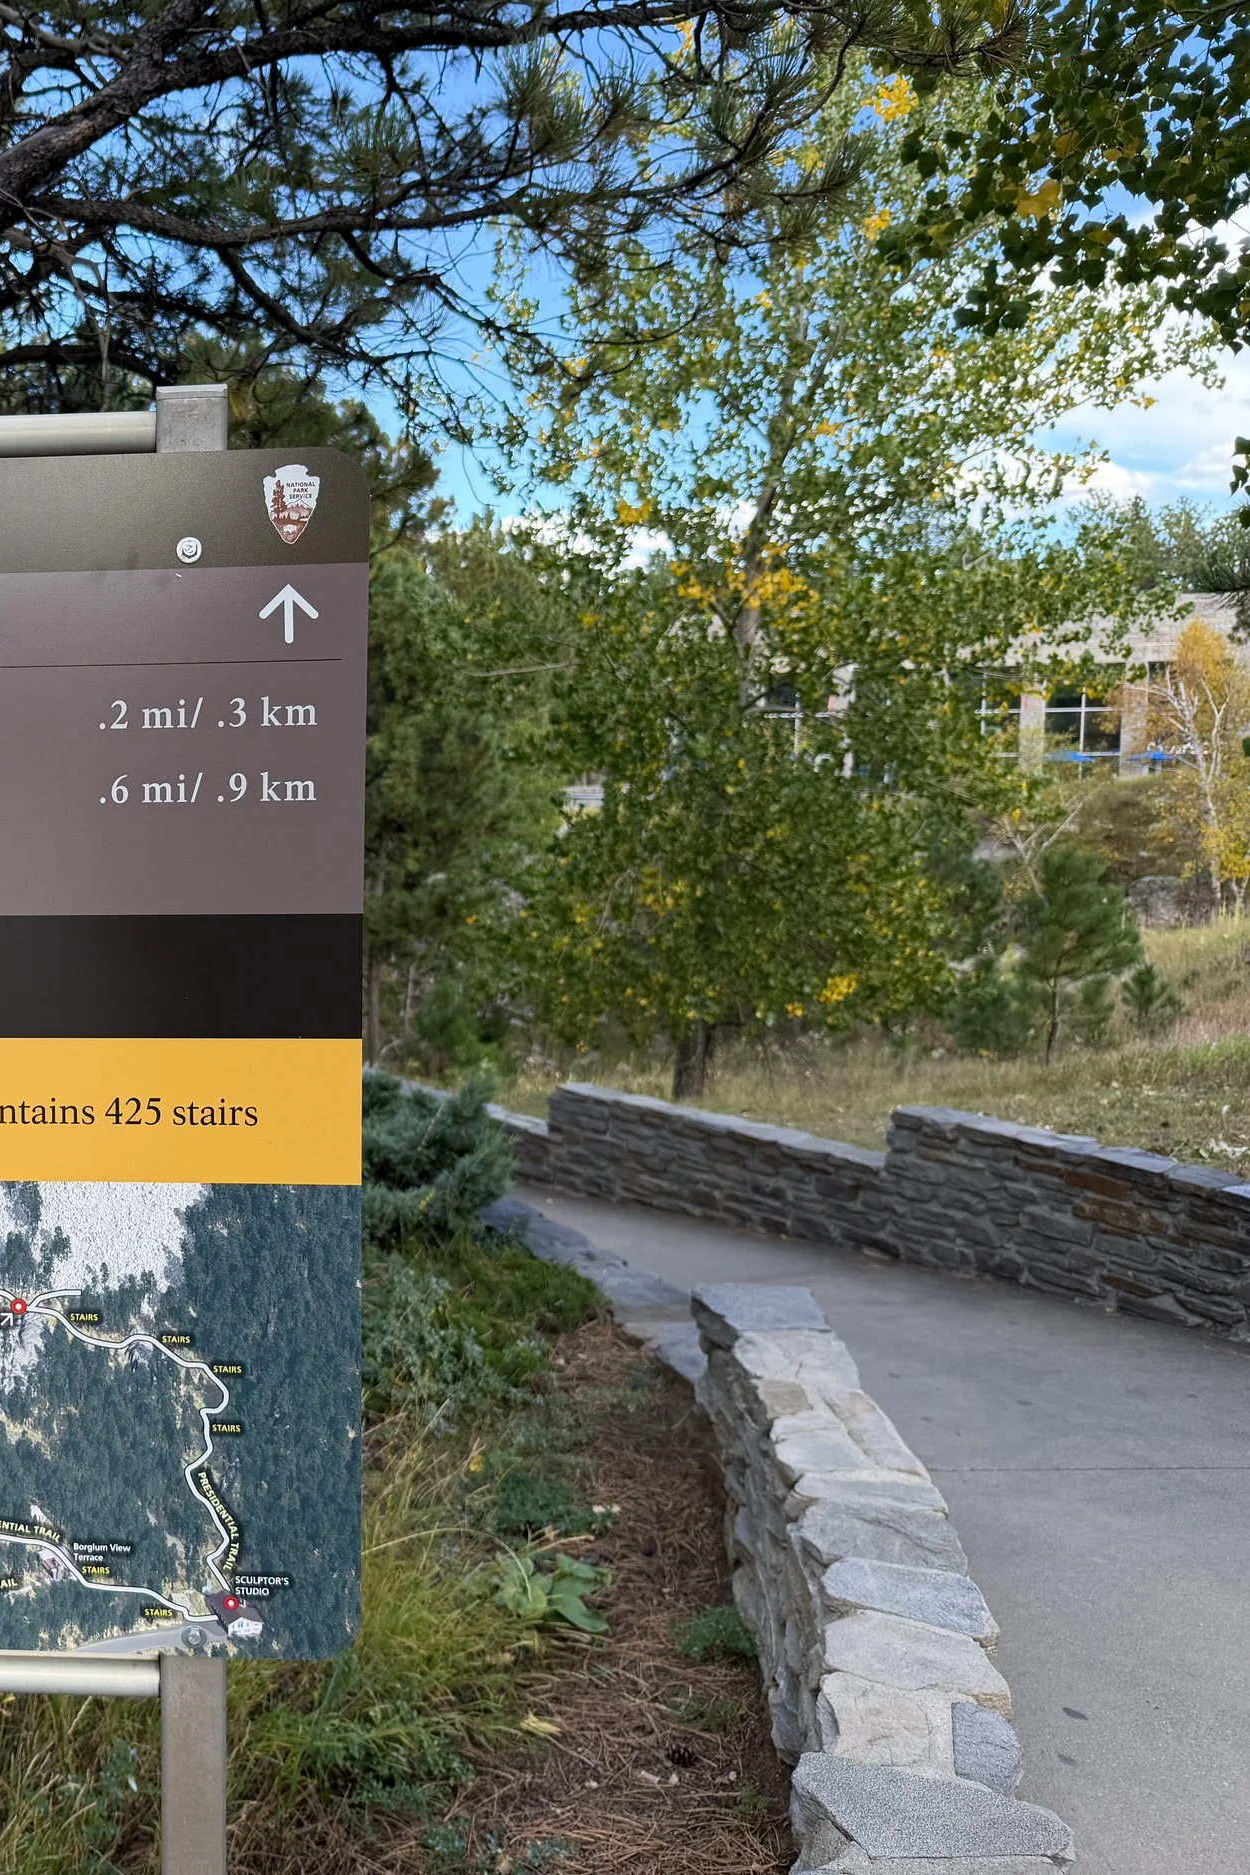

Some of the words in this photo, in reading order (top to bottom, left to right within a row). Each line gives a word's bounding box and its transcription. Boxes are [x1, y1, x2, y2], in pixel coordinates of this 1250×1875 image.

[99, 700, 129, 730] .2
[217, 698, 247, 728] .3
[260, 696, 318, 727] km
[99, 774, 129, 804] .6
[217, 773, 247, 803] .9
[260, 772, 317, 802] km
[104, 1097, 163, 1126] 425
[171, 1097, 259, 1127] stairs
[70, 1312, 99, 1322] STAIRS
[161, 1335, 191, 1345] STAIRS
[213, 1365, 242, 1374] STAIRS
[212, 1423, 241, 1433] STAIRS
[198, 1471, 240, 1540] PRESIDENTIAL
[222, 1542, 240, 1571] TRAIL
[33, 1525, 61, 1542] TRAIL
[73, 1542, 108, 1553] Borglum
[109, 1543, 131, 1552] View
[73, 1552, 103, 1562] Terrace
[81, 1565, 110, 1575] STAIRS
[235, 1575, 290, 1586] SCULPTOR'S
[235, 1586, 270, 1596] STUDIO
[144, 1608, 173, 1617] STAIRS
